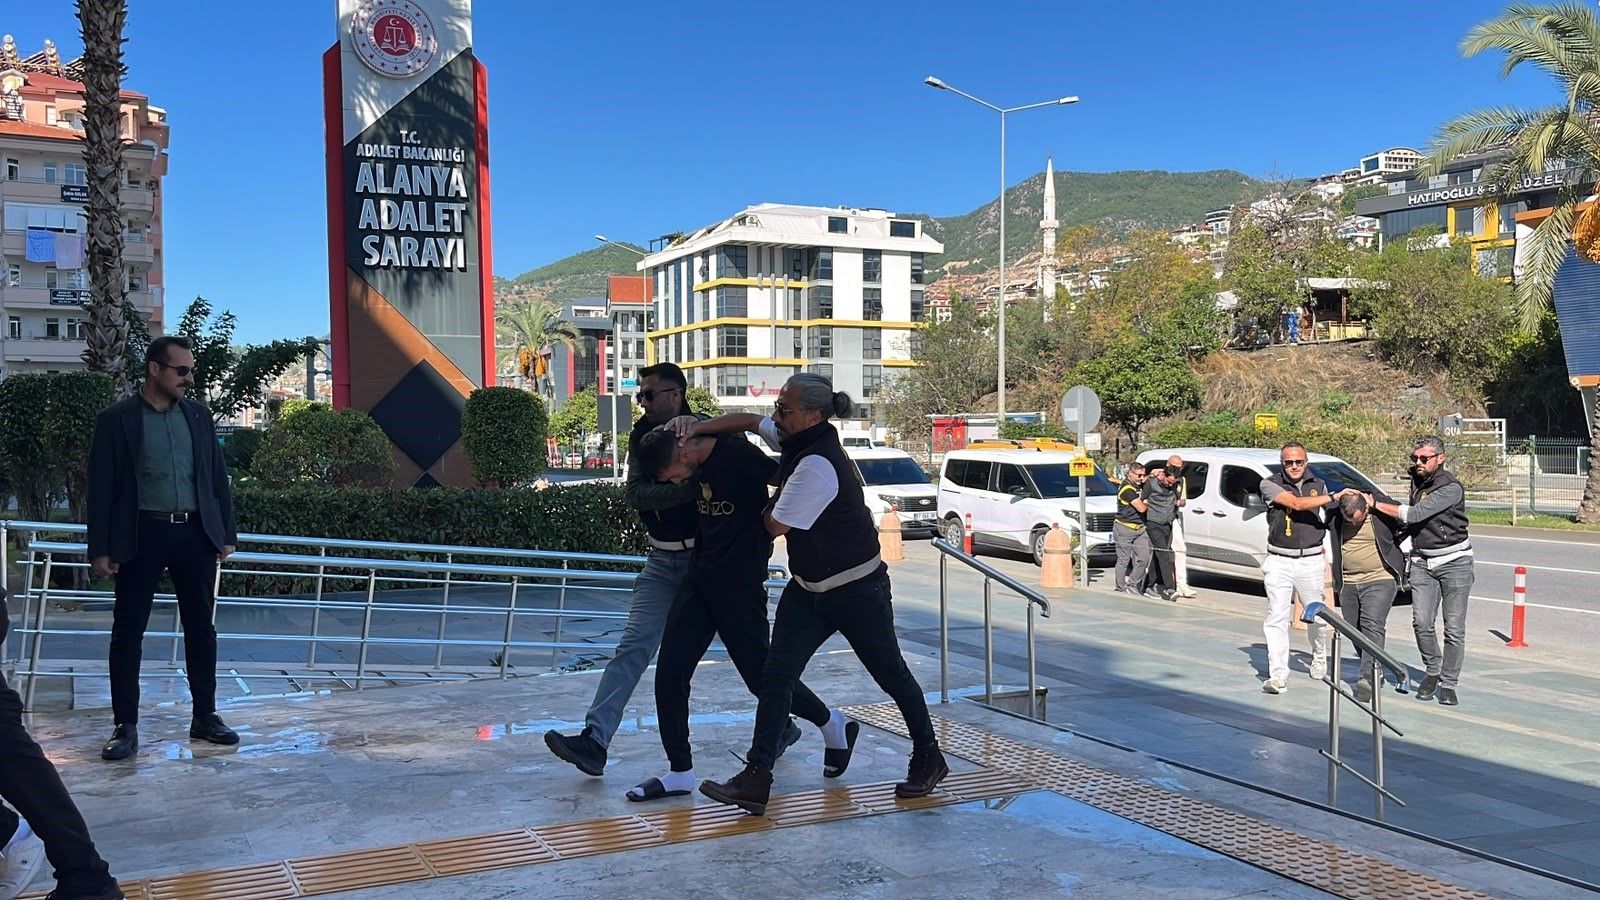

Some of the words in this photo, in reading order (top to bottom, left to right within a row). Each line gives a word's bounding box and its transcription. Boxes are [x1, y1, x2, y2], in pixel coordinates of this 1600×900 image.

[356, 143, 400, 158] ADALET
[403, 146, 465, 162] BAKANLIĞI
[400, 130, 421, 144] T.C.
[355, 162, 468, 197] ALANYA
[358, 198, 466, 233] ADALET
[362, 234, 465, 268] SARAYI
